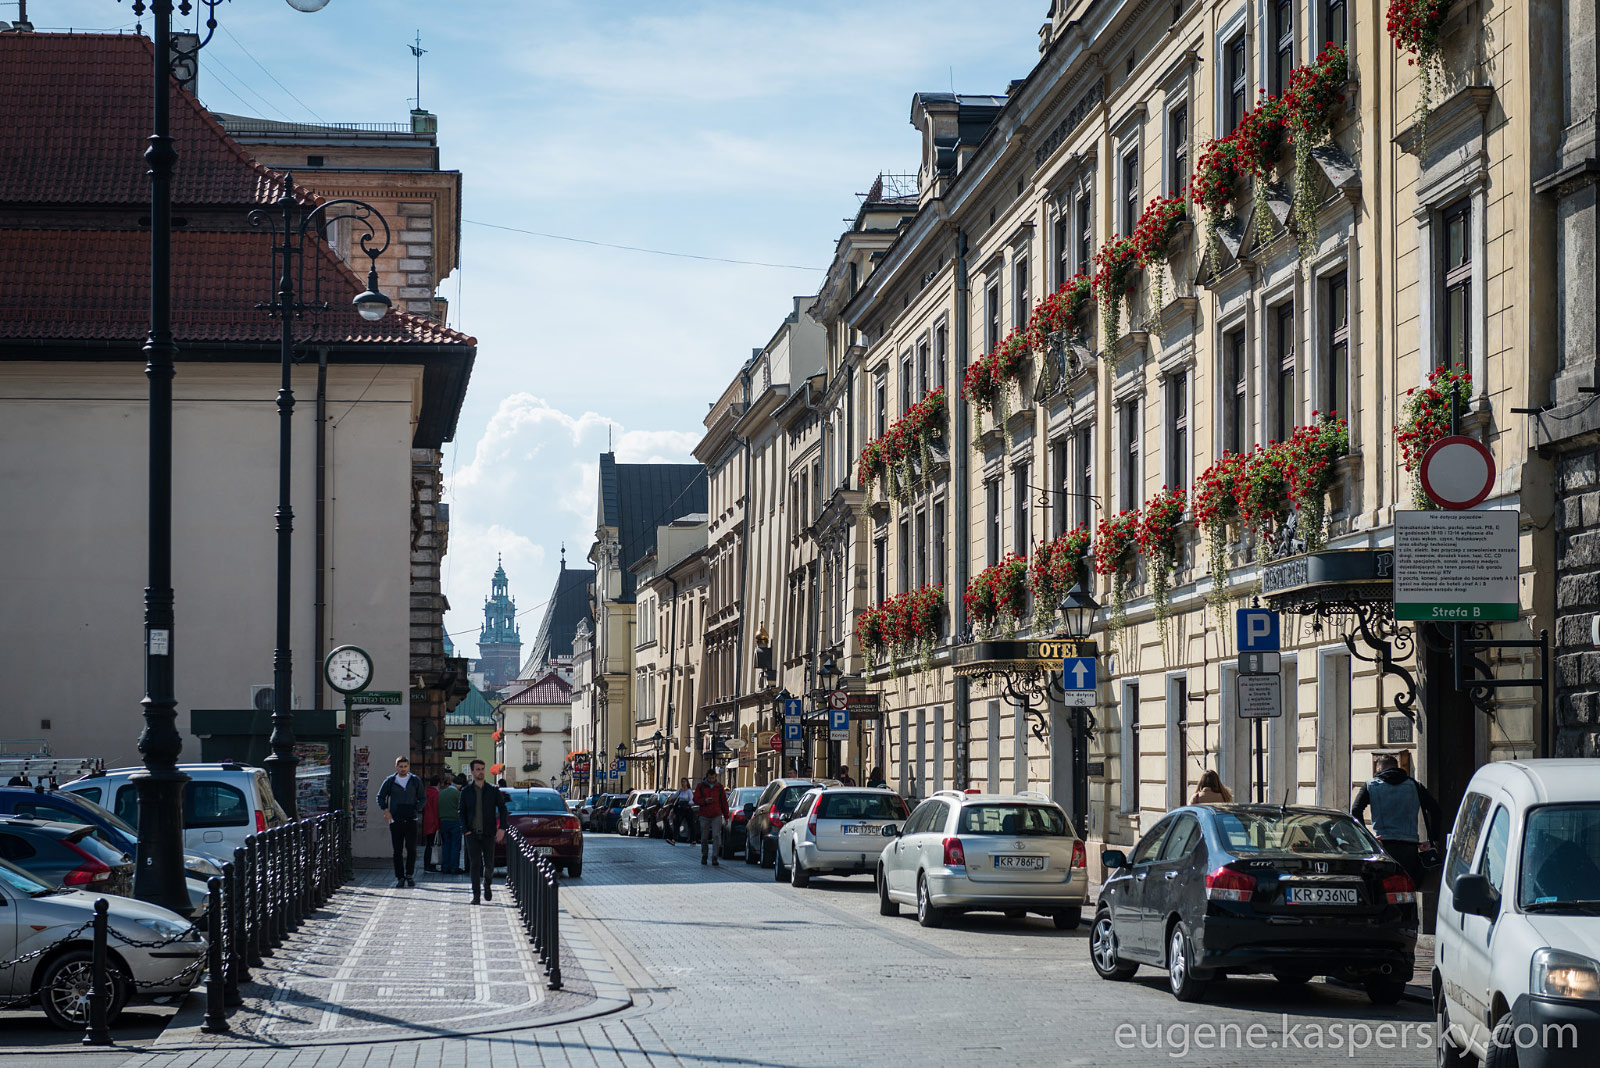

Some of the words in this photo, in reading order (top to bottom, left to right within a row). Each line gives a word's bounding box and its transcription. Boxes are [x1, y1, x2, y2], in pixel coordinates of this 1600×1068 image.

[1432, 606, 1468, 617] Strefa
[1473, 606, 1481, 617] B
[1246, 614, 1271, 646] P
[834, 712, 845, 727] P
[789, 726, 798, 738] P
[1000, 858, 1013, 866] KR
[1016, 858, 1041, 867] 786FC
[1294, 889, 1312, 901] KR
[1316, 889, 1355, 901] 936NC
